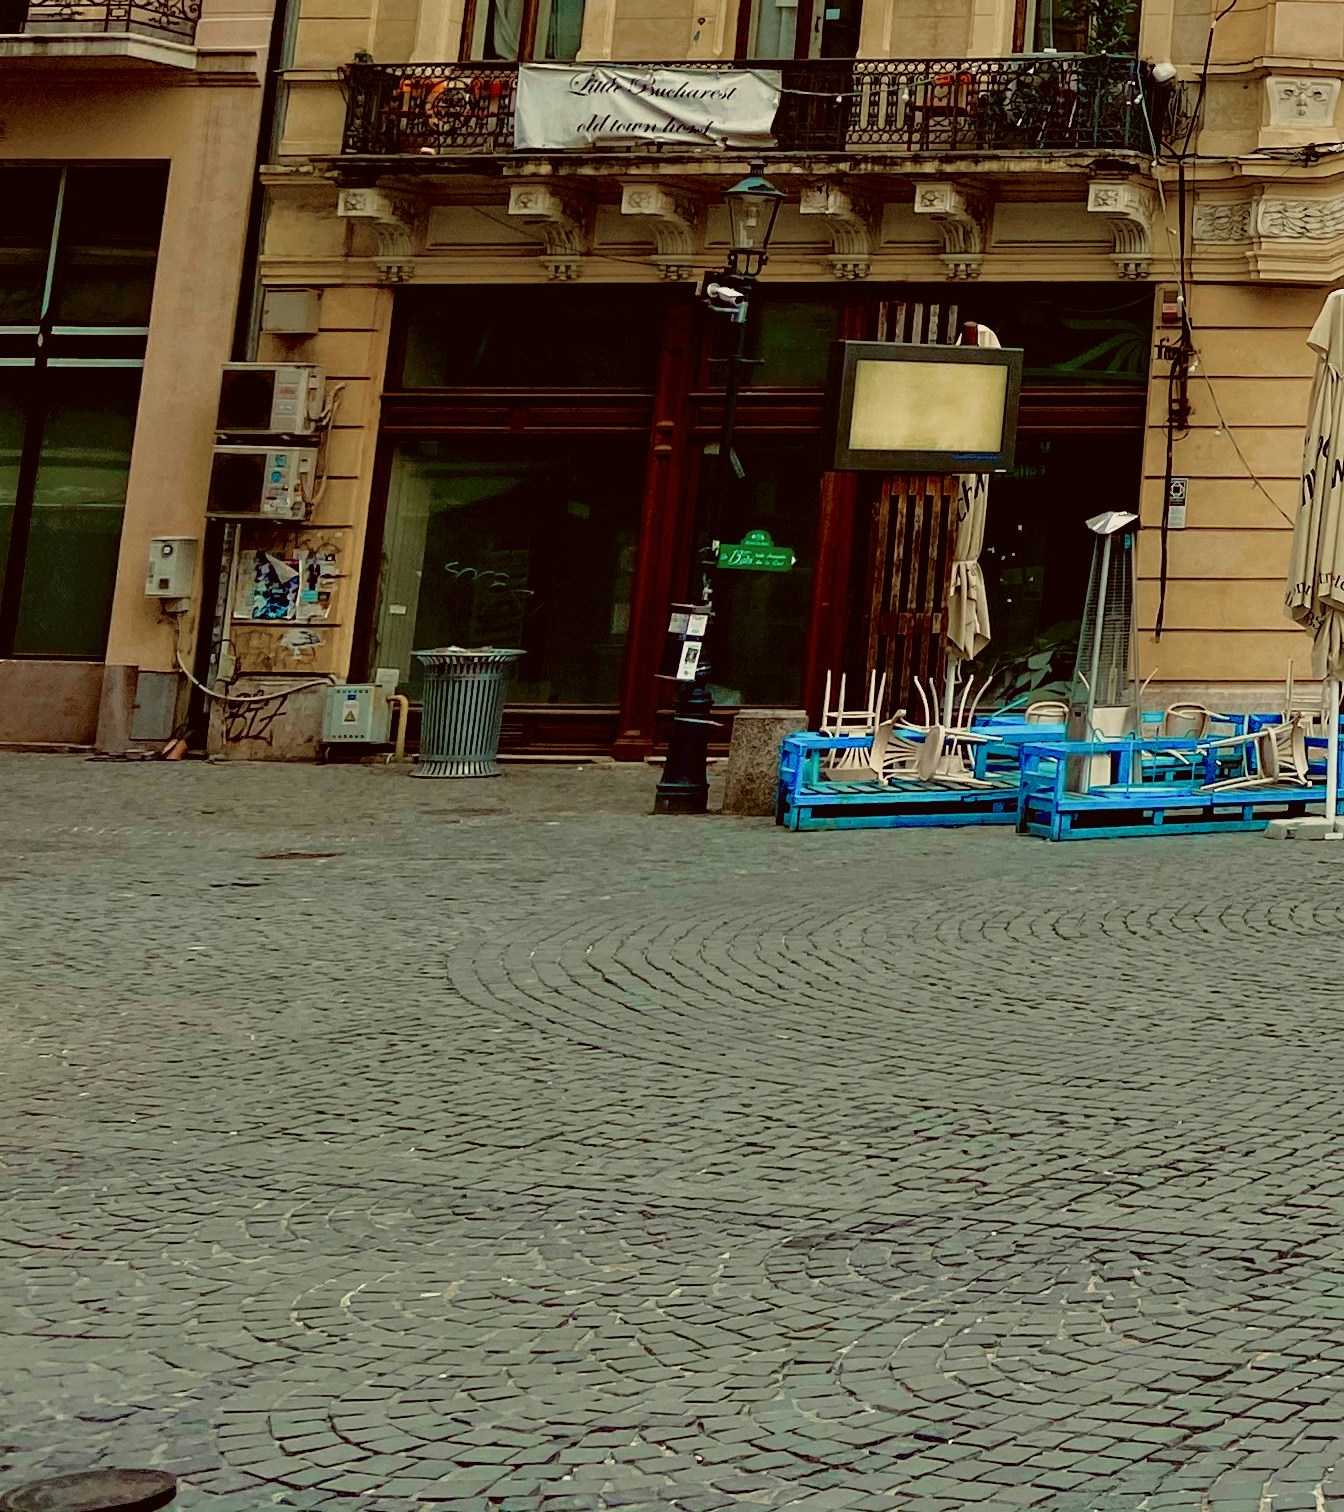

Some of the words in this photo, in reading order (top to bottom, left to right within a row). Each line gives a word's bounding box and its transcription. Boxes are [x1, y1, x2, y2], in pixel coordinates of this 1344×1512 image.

[629, 77, 737, 101] Bucharest
[577, 114, 610, 134] old
[610, 114, 657, 133] town
